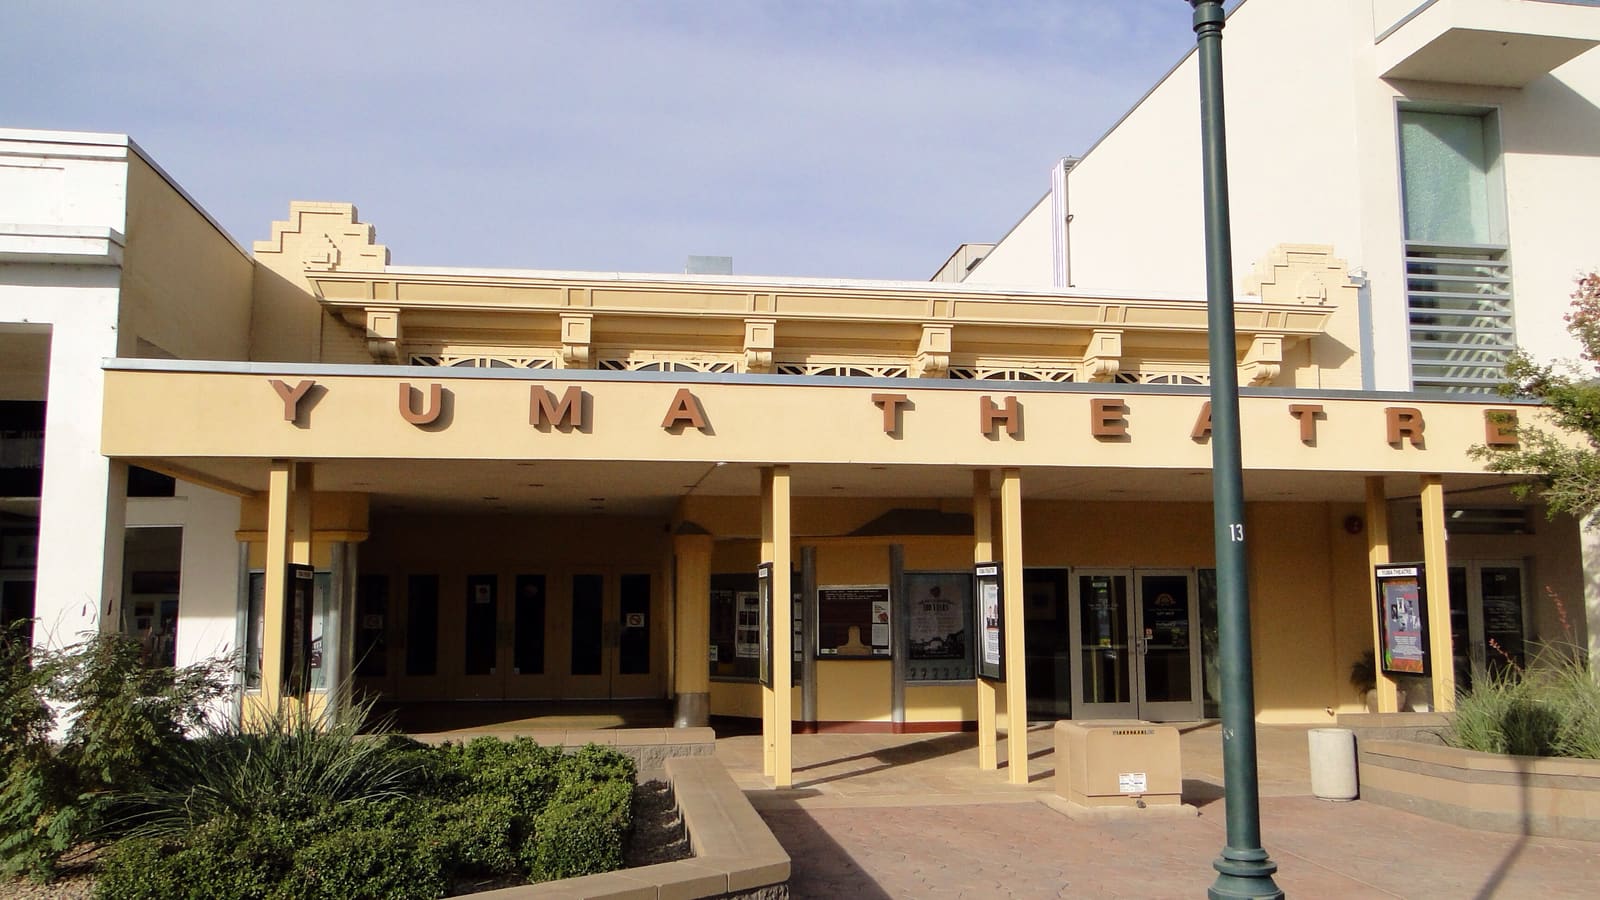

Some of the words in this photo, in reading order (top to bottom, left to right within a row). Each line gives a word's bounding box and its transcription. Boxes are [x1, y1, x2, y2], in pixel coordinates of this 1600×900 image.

[268, 379, 707, 429] YUMA
[871, 393, 1518, 446] THEATRE
[1229, 523, 1244, 542] 13
